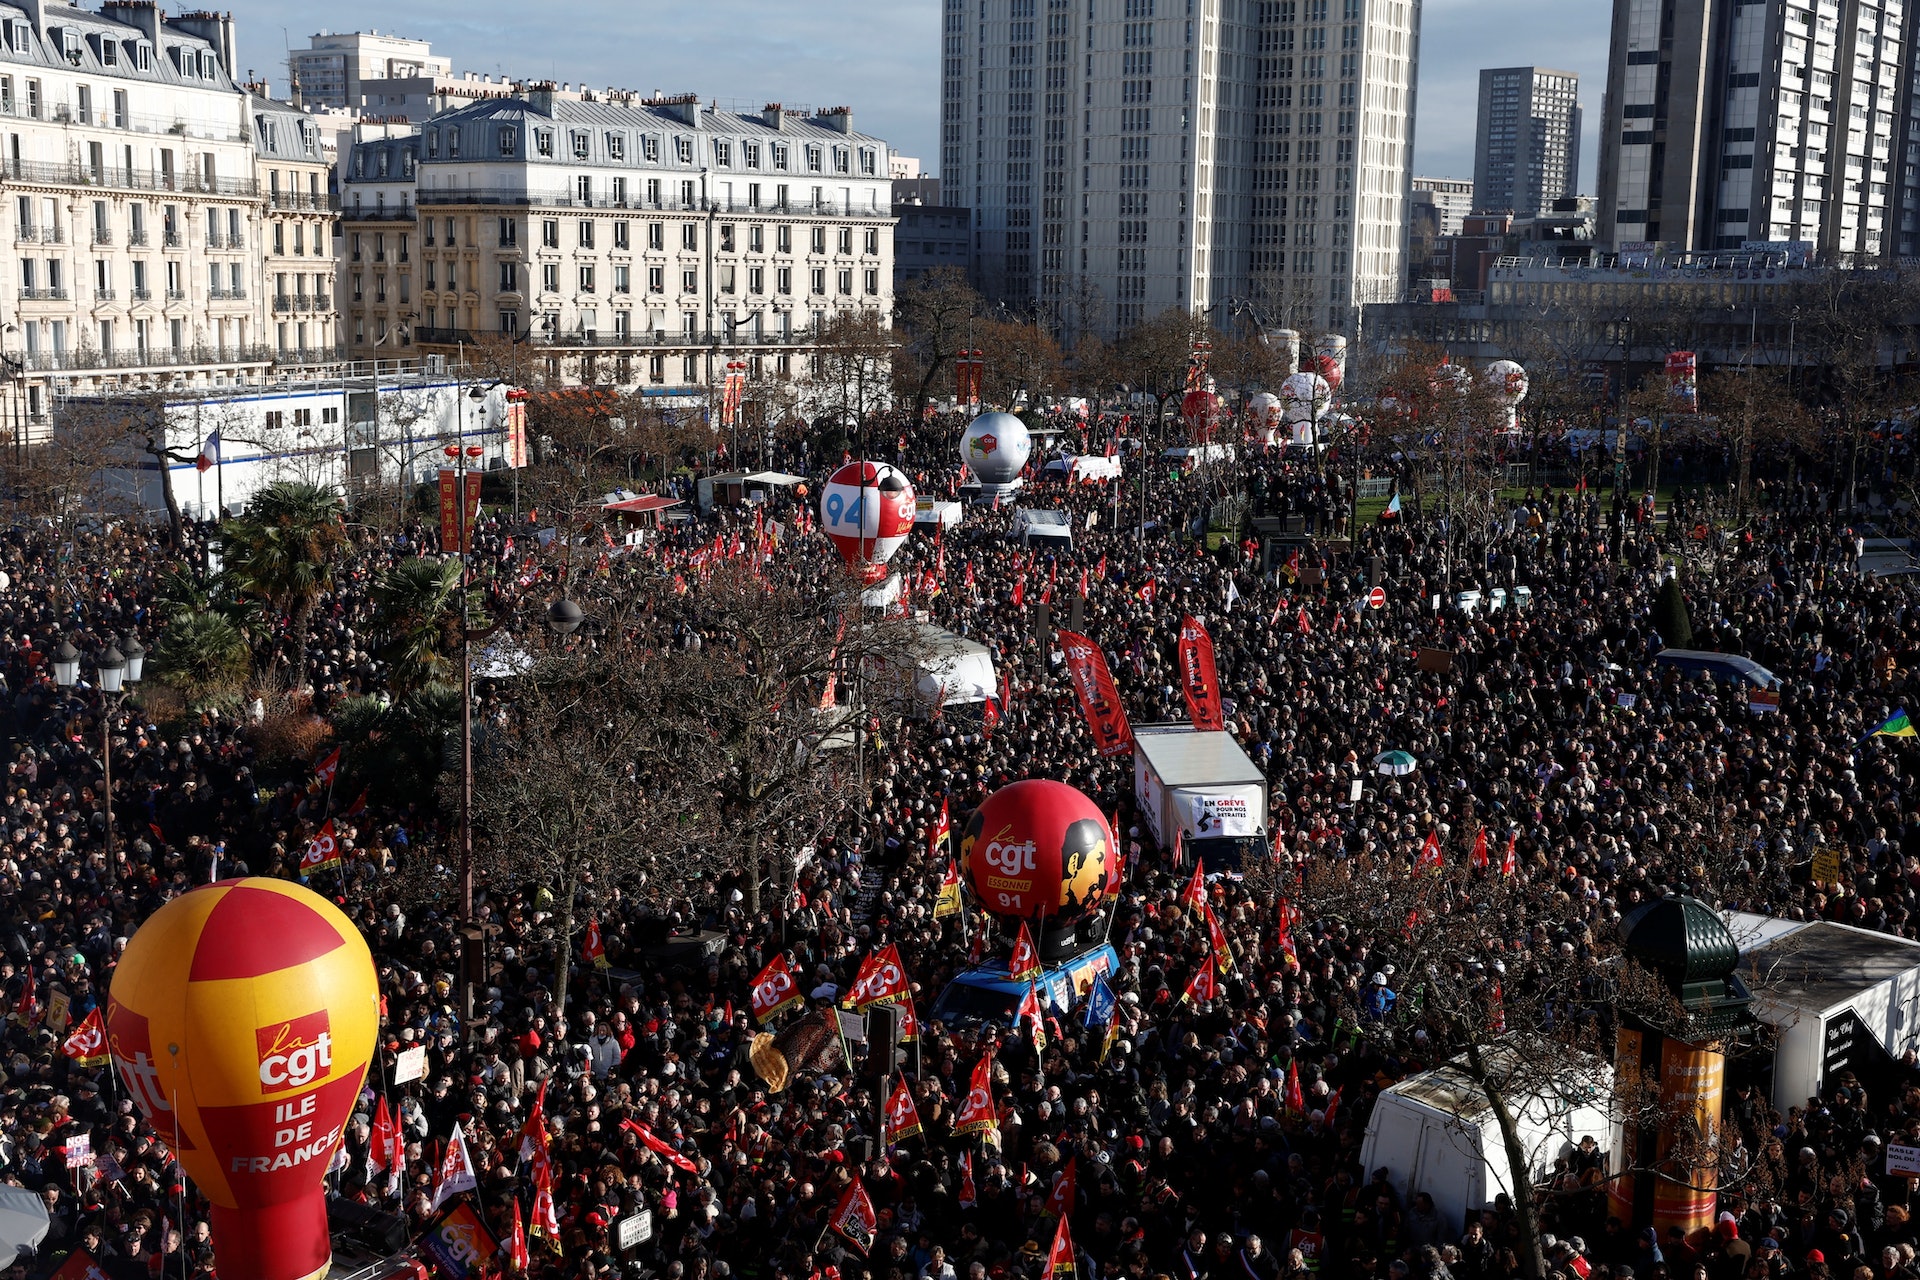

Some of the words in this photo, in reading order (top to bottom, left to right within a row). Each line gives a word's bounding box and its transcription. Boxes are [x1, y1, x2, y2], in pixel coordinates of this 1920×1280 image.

[827, 493, 867, 530] 94
[985, 840, 1037, 876] cgt
[988, 877, 1031, 890] ESSONNE
[998, 893, 1022, 909] 91
[263, 1023, 325, 1059] la
[1840, 1019, 1855, 1035] Chef
[259, 1032, 332, 1087] cgt
[275, 1094, 317, 1124] ILE
[66, 1134, 90, 1146] NOS
[231, 1124, 341, 1174] FRANCE
[275, 1121, 313, 1148] DE
[440, 1226, 481, 1268] cgt
